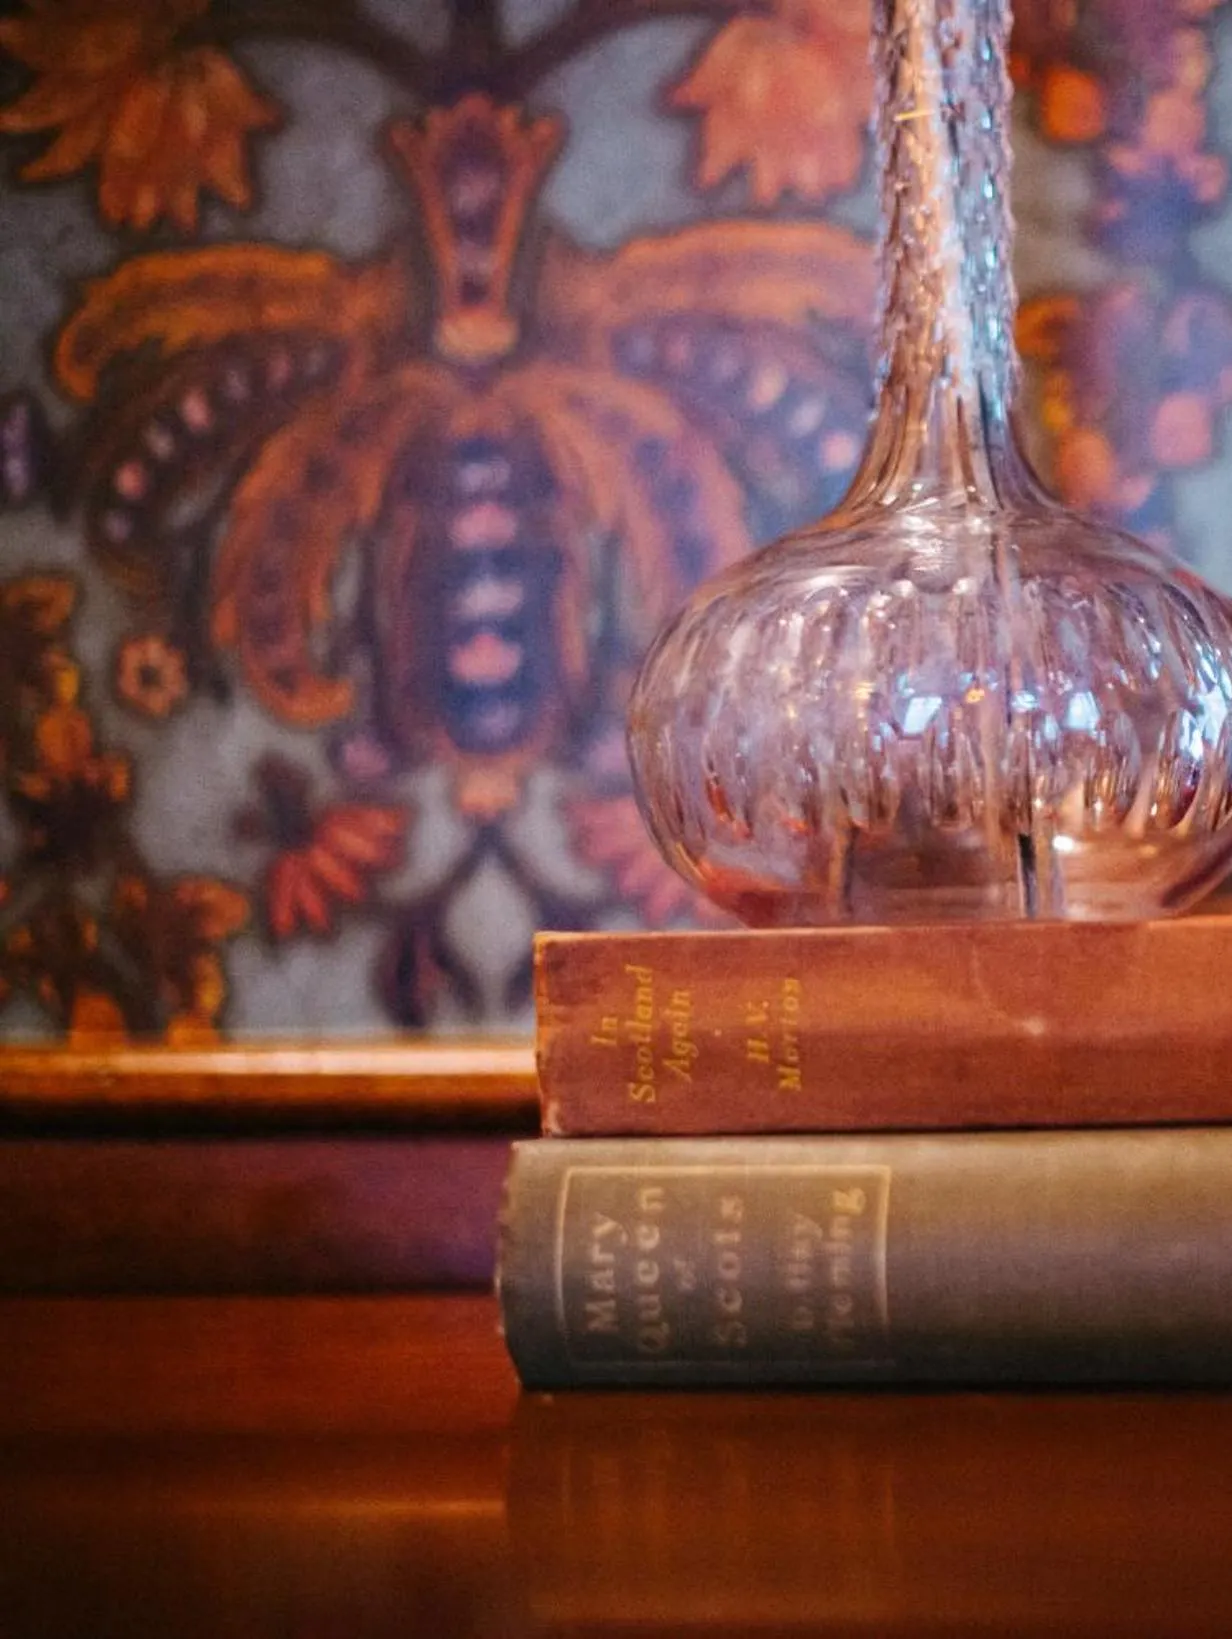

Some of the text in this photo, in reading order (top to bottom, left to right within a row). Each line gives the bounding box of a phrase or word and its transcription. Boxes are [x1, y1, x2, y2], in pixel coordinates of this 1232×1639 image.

[591, 1016, 618, 1046] In
[624, 964, 655, 1103] Scotland
[662, 989, 699, 1084] Again
[776, 978, 801, 1092] Morton
[585, 1212, 628, 1333] Mary
[636, 1186, 671, 1351] Queen
[714, 1194, 747, 1347] Scots
